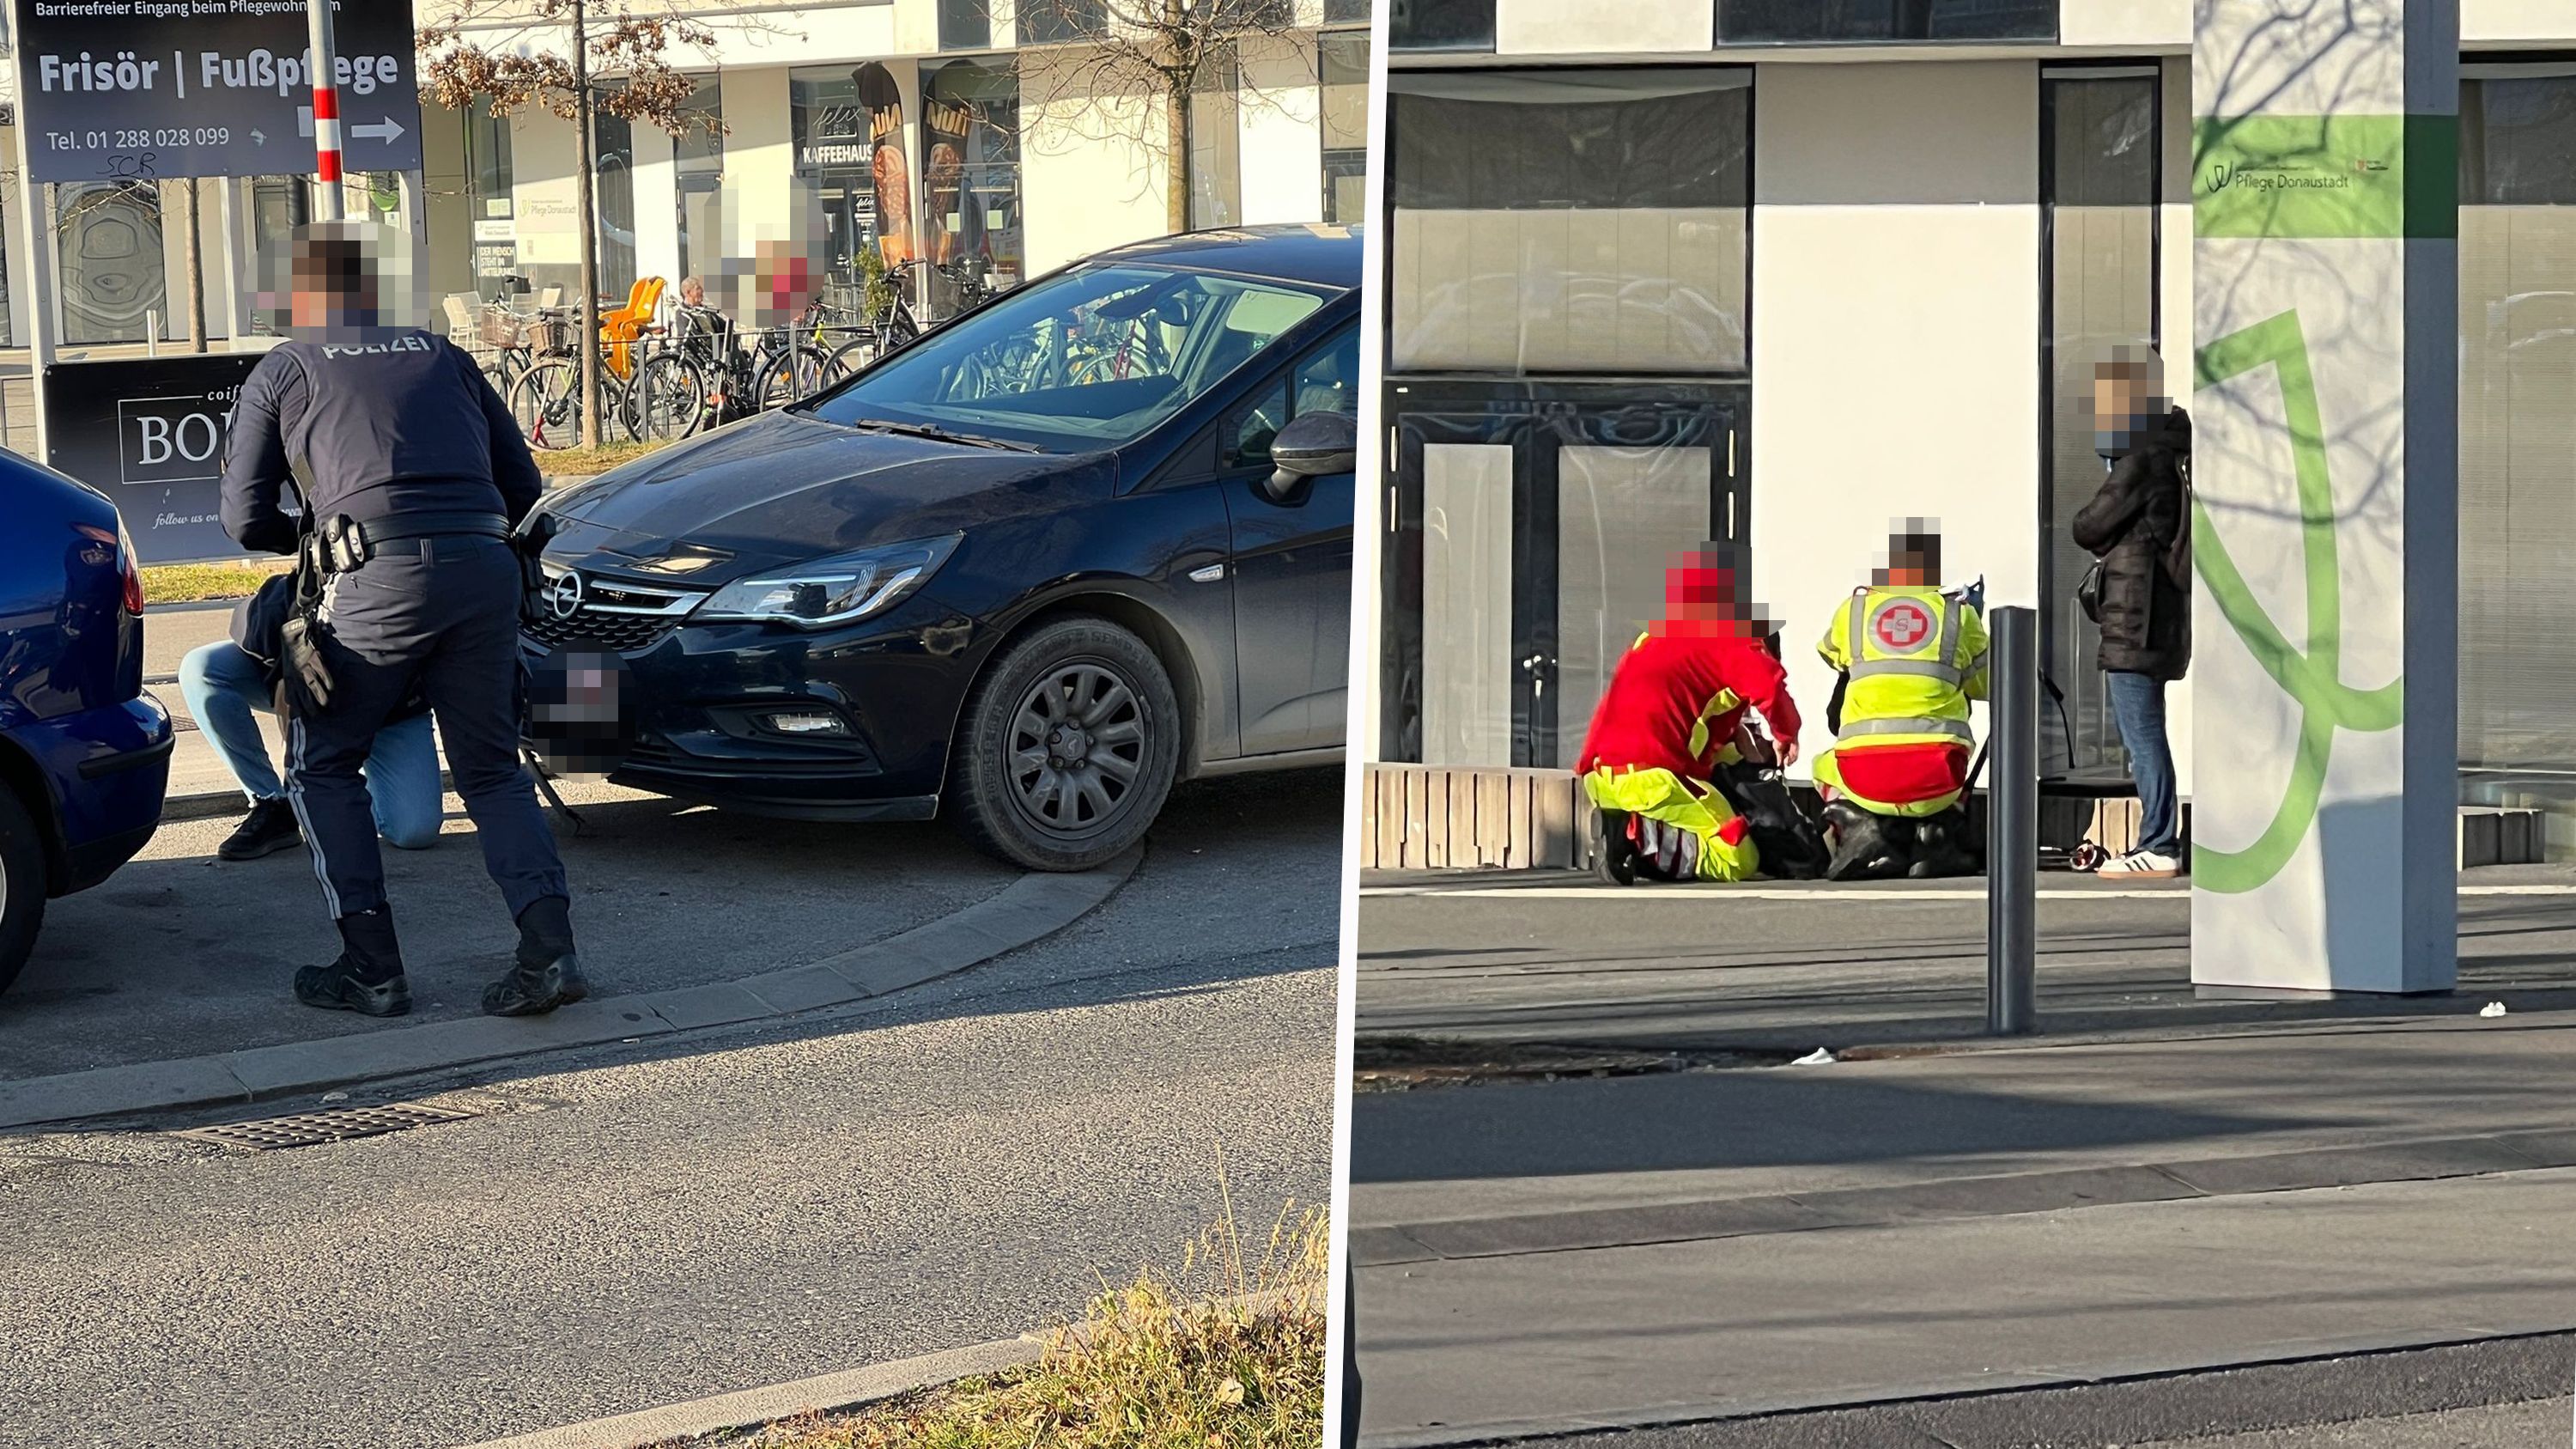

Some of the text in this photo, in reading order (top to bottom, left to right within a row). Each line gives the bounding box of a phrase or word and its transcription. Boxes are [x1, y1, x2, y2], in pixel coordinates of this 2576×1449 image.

[35, 0, 341, 18] Barrierefreier Eingang beim Pflegewohnm
[39, 52, 159, 91] Frisör
[200, 48, 398, 96] Fußpfege
[46, 127, 230, 150] Tel. 01 288 028 099
[803, 144, 872, 163] KAFFEEHAUS
[2235, 174, 2348, 192] Pflege Donaustadt
[137, 412, 232, 465] BO
[152, 513, 188, 529] follow
